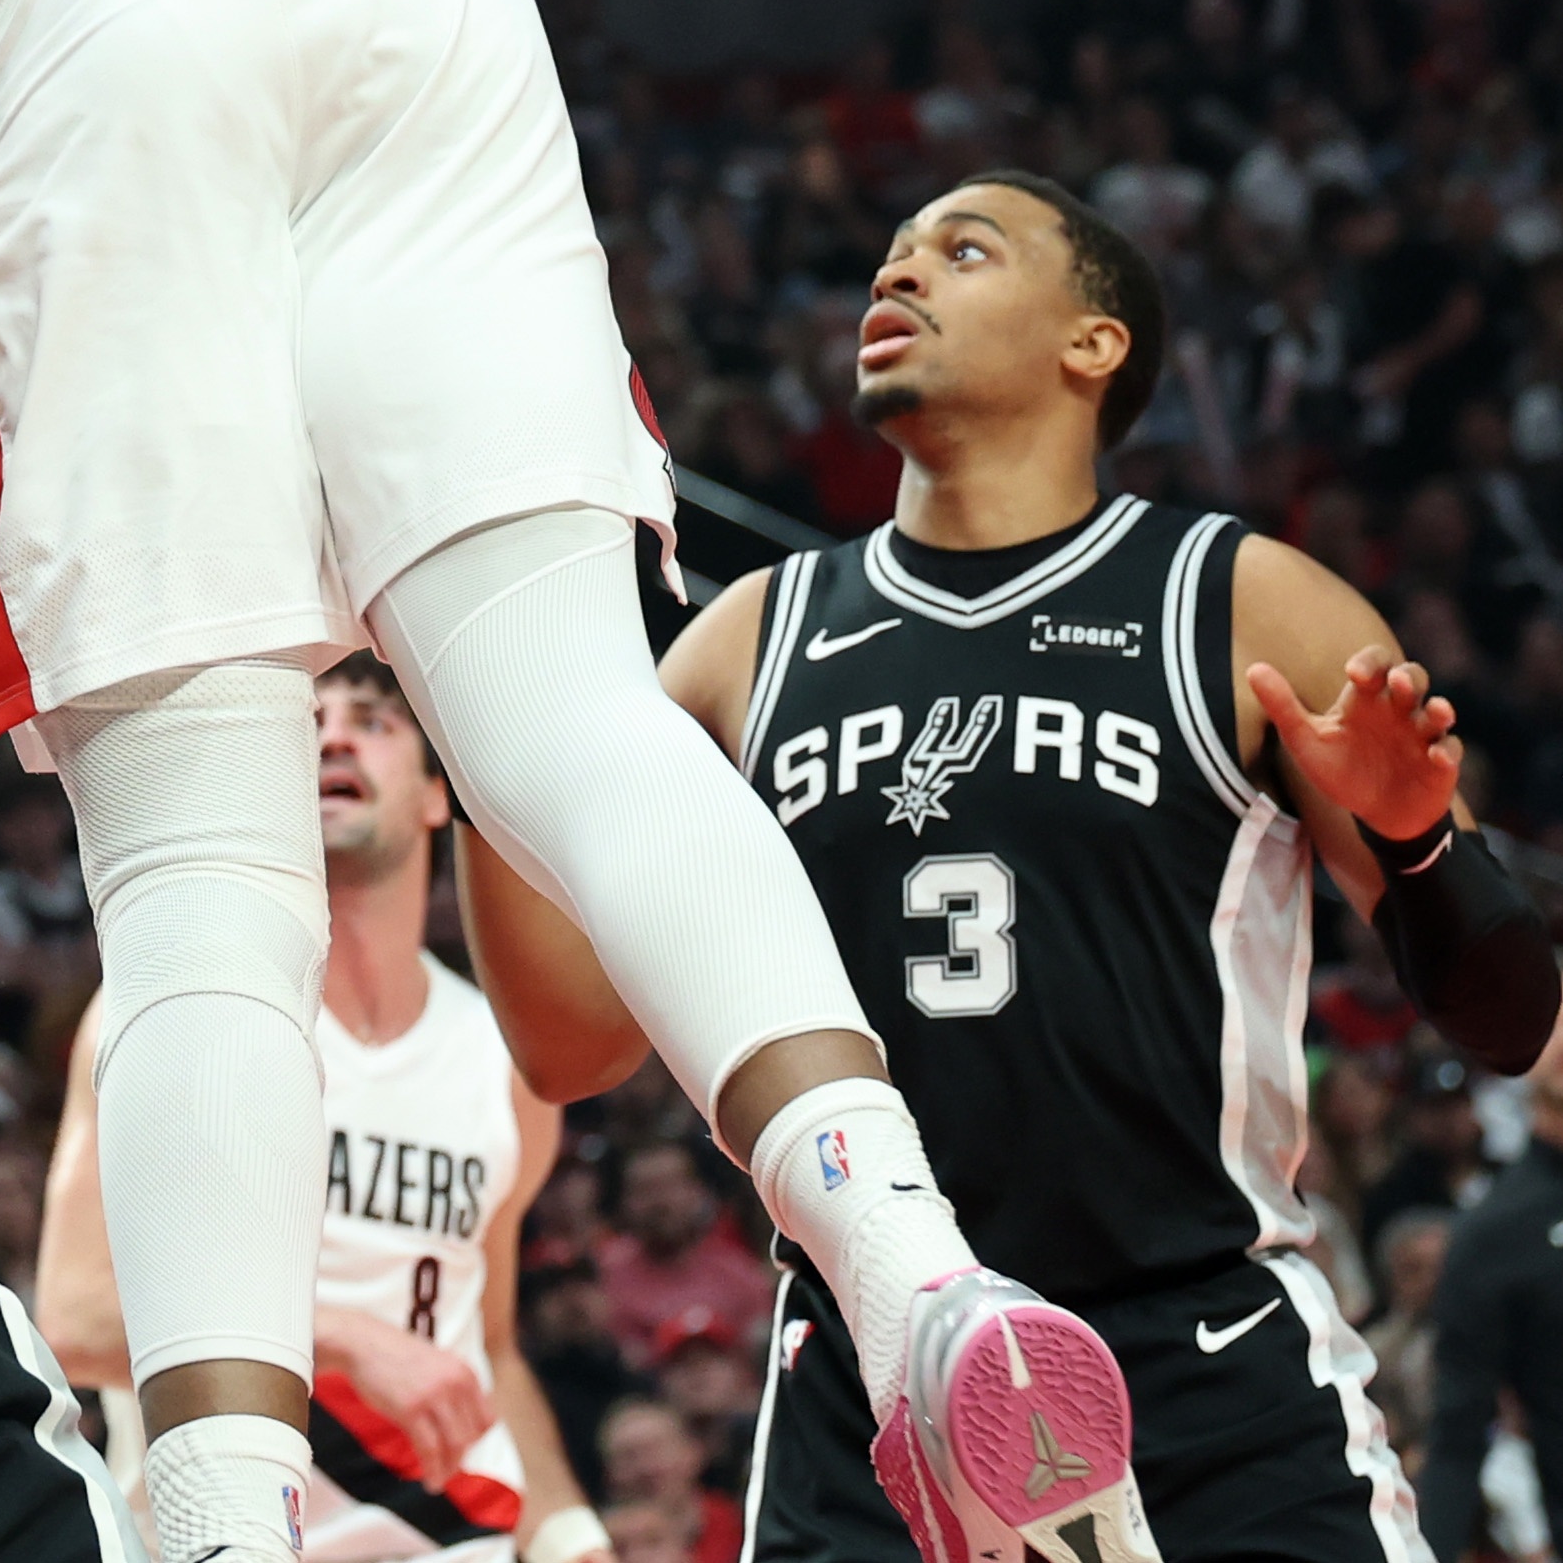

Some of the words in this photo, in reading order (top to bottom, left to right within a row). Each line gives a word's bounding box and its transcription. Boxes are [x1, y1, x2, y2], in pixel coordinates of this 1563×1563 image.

[1044, 624, 1128, 649] LEDGER
[772, 693, 1161, 836] SPURS
[902, 852, 1018, 1019] 3
[326, 1129, 485, 1238] AZERS
[408, 1256, 439, 1340] 8
